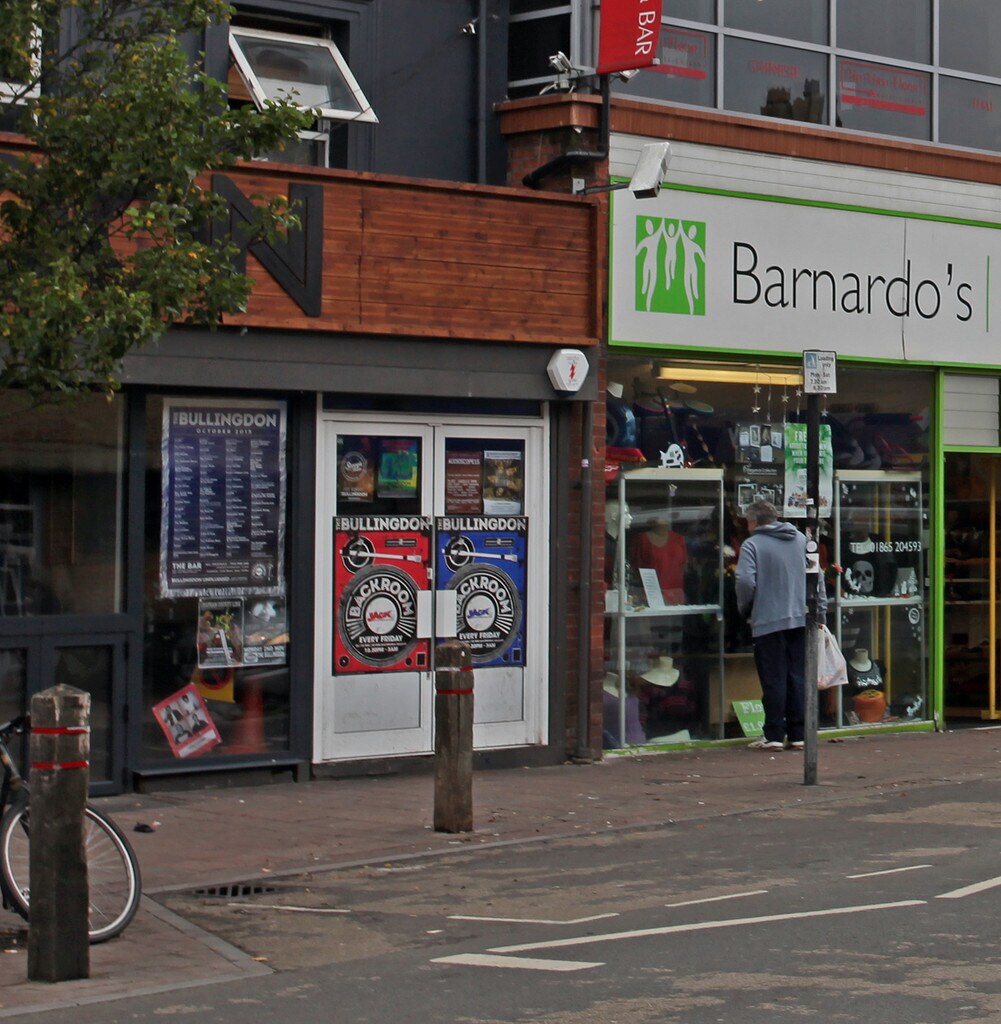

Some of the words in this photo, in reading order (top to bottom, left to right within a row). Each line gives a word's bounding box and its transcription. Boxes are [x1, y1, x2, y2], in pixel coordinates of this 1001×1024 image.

[634, 10, 656, 56] BAR
[732, 241, 973, 322] Barnardo's
[179, 411, 277, 427] BULLINGDON
[341, 517, 430, 531] BULLINGDON
[443, 517, 526, 531] BULLINGDON
[869, 542, 893, 552] 01865
[895, 541, 922, 553] 204593
[349, 578, 415, 617] BACKROOM
